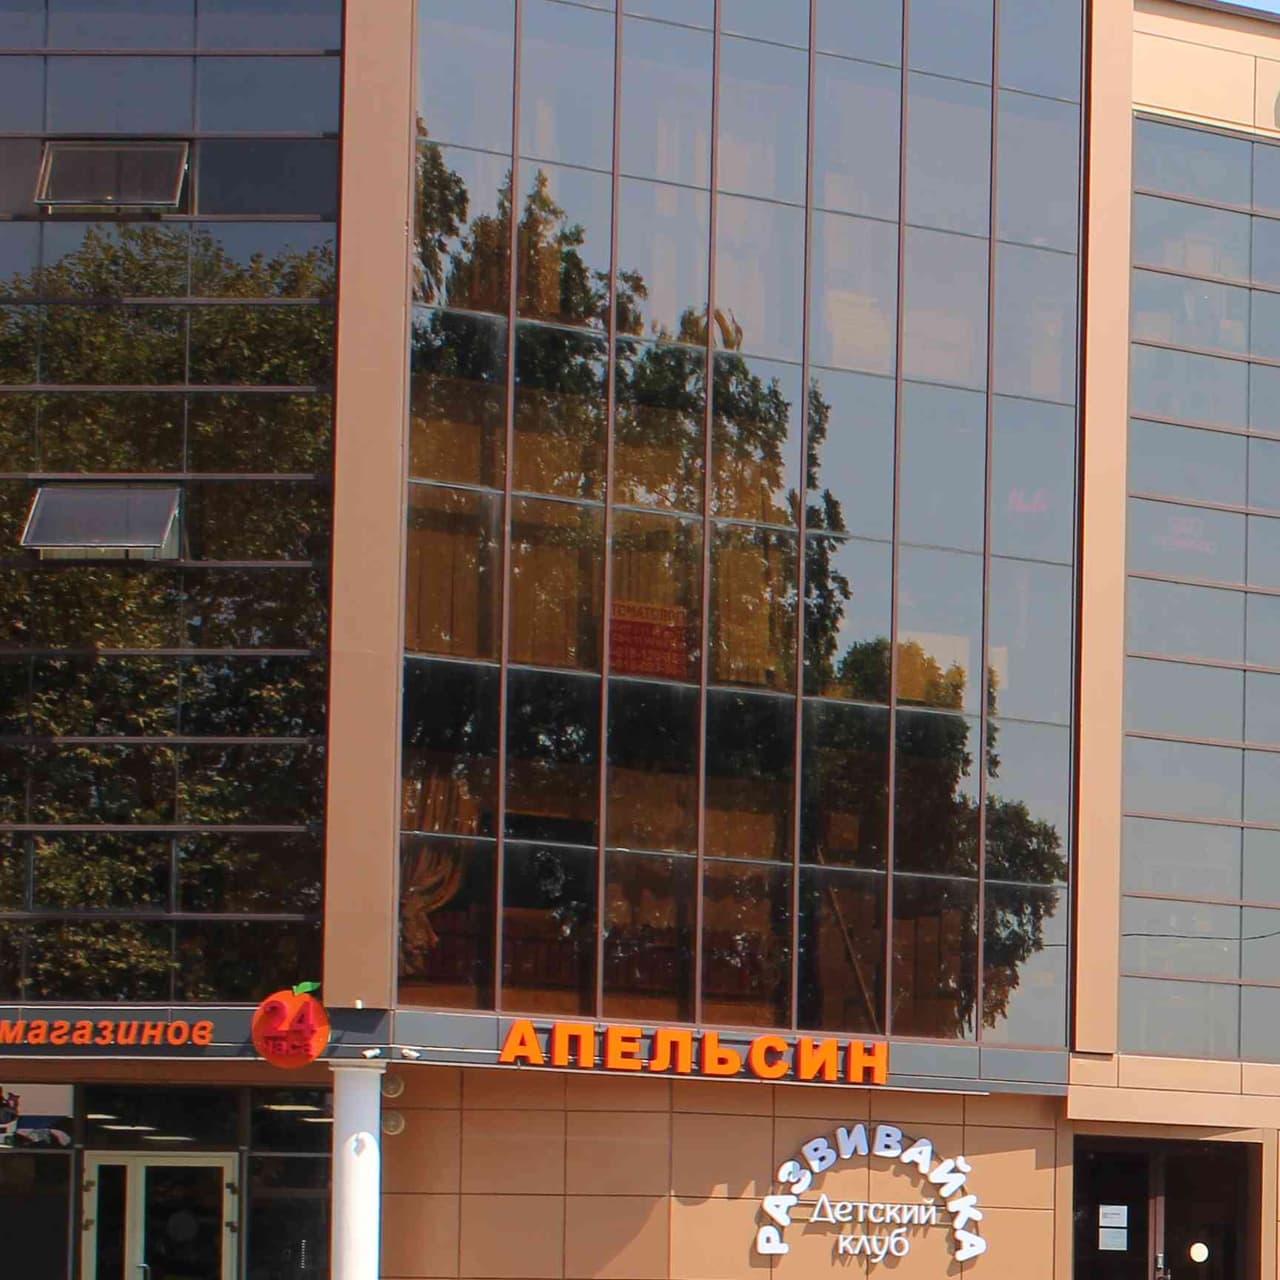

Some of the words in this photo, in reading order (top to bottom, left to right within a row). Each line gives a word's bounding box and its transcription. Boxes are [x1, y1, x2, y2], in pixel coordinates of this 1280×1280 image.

[0, 1018, 214, 1046] магазинов
[263, 1000, 317, 1037] 24
[499, 1019, 889, 1085] АПЕЛЬСИН
[757, 1123, 987, 1261] РАЗВИВАЙКА
[809, 1193, 938, 1224] Детский
[838, 1227, 910, 1263] клуб
